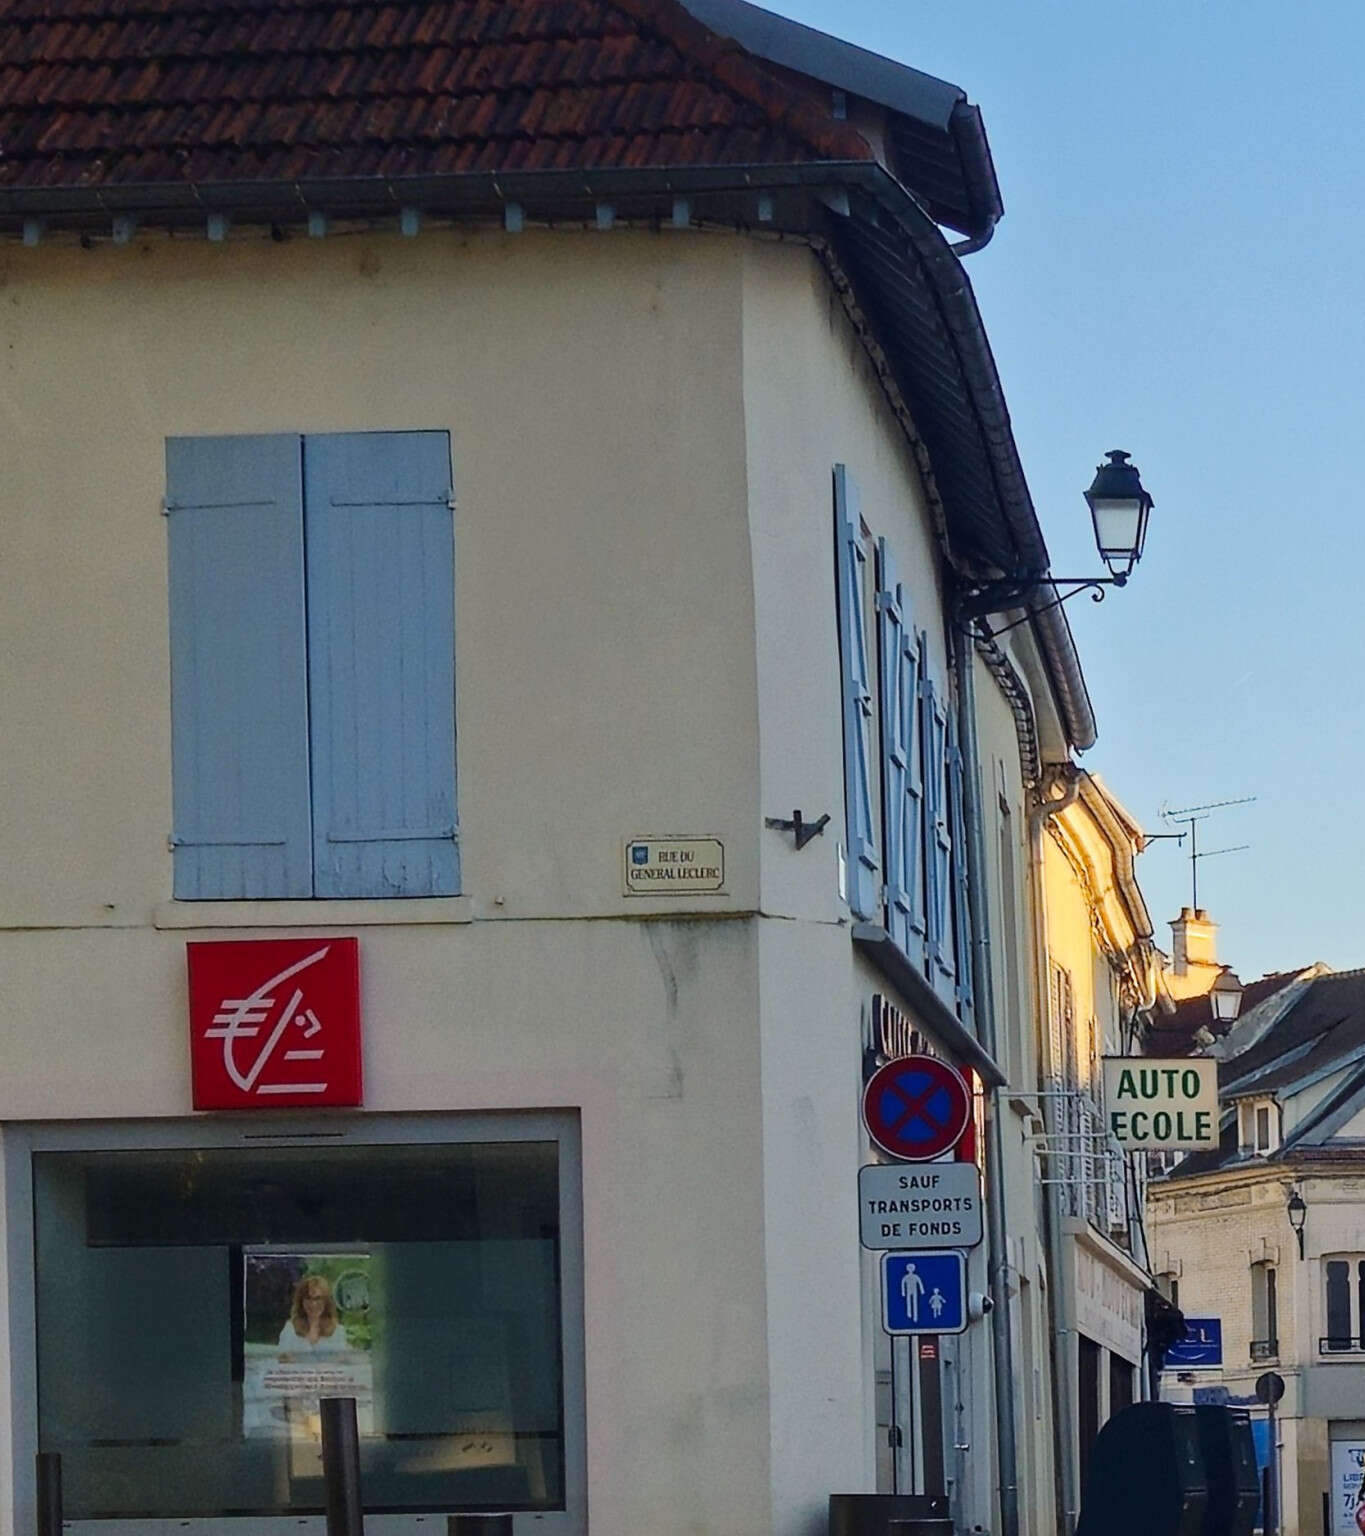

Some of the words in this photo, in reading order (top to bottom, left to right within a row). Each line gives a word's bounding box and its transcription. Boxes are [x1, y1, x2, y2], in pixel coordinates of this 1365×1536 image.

[659, 851, 678, 862] RUE
[680, 851, 695, 862] DU
[677, 867, 720, 879] LECLERC
[1117, 1069, 1200, 1099] AUTO
[1111, 1111, 1211, 1141] ECOLE
[899, 1175, 941, 1189] SAUF
[868, 1197, 973, 1215] TRANSPORTS
[881, 1223, 901, 1237] DE
[909, 1221, 962, 1236] FONDS
